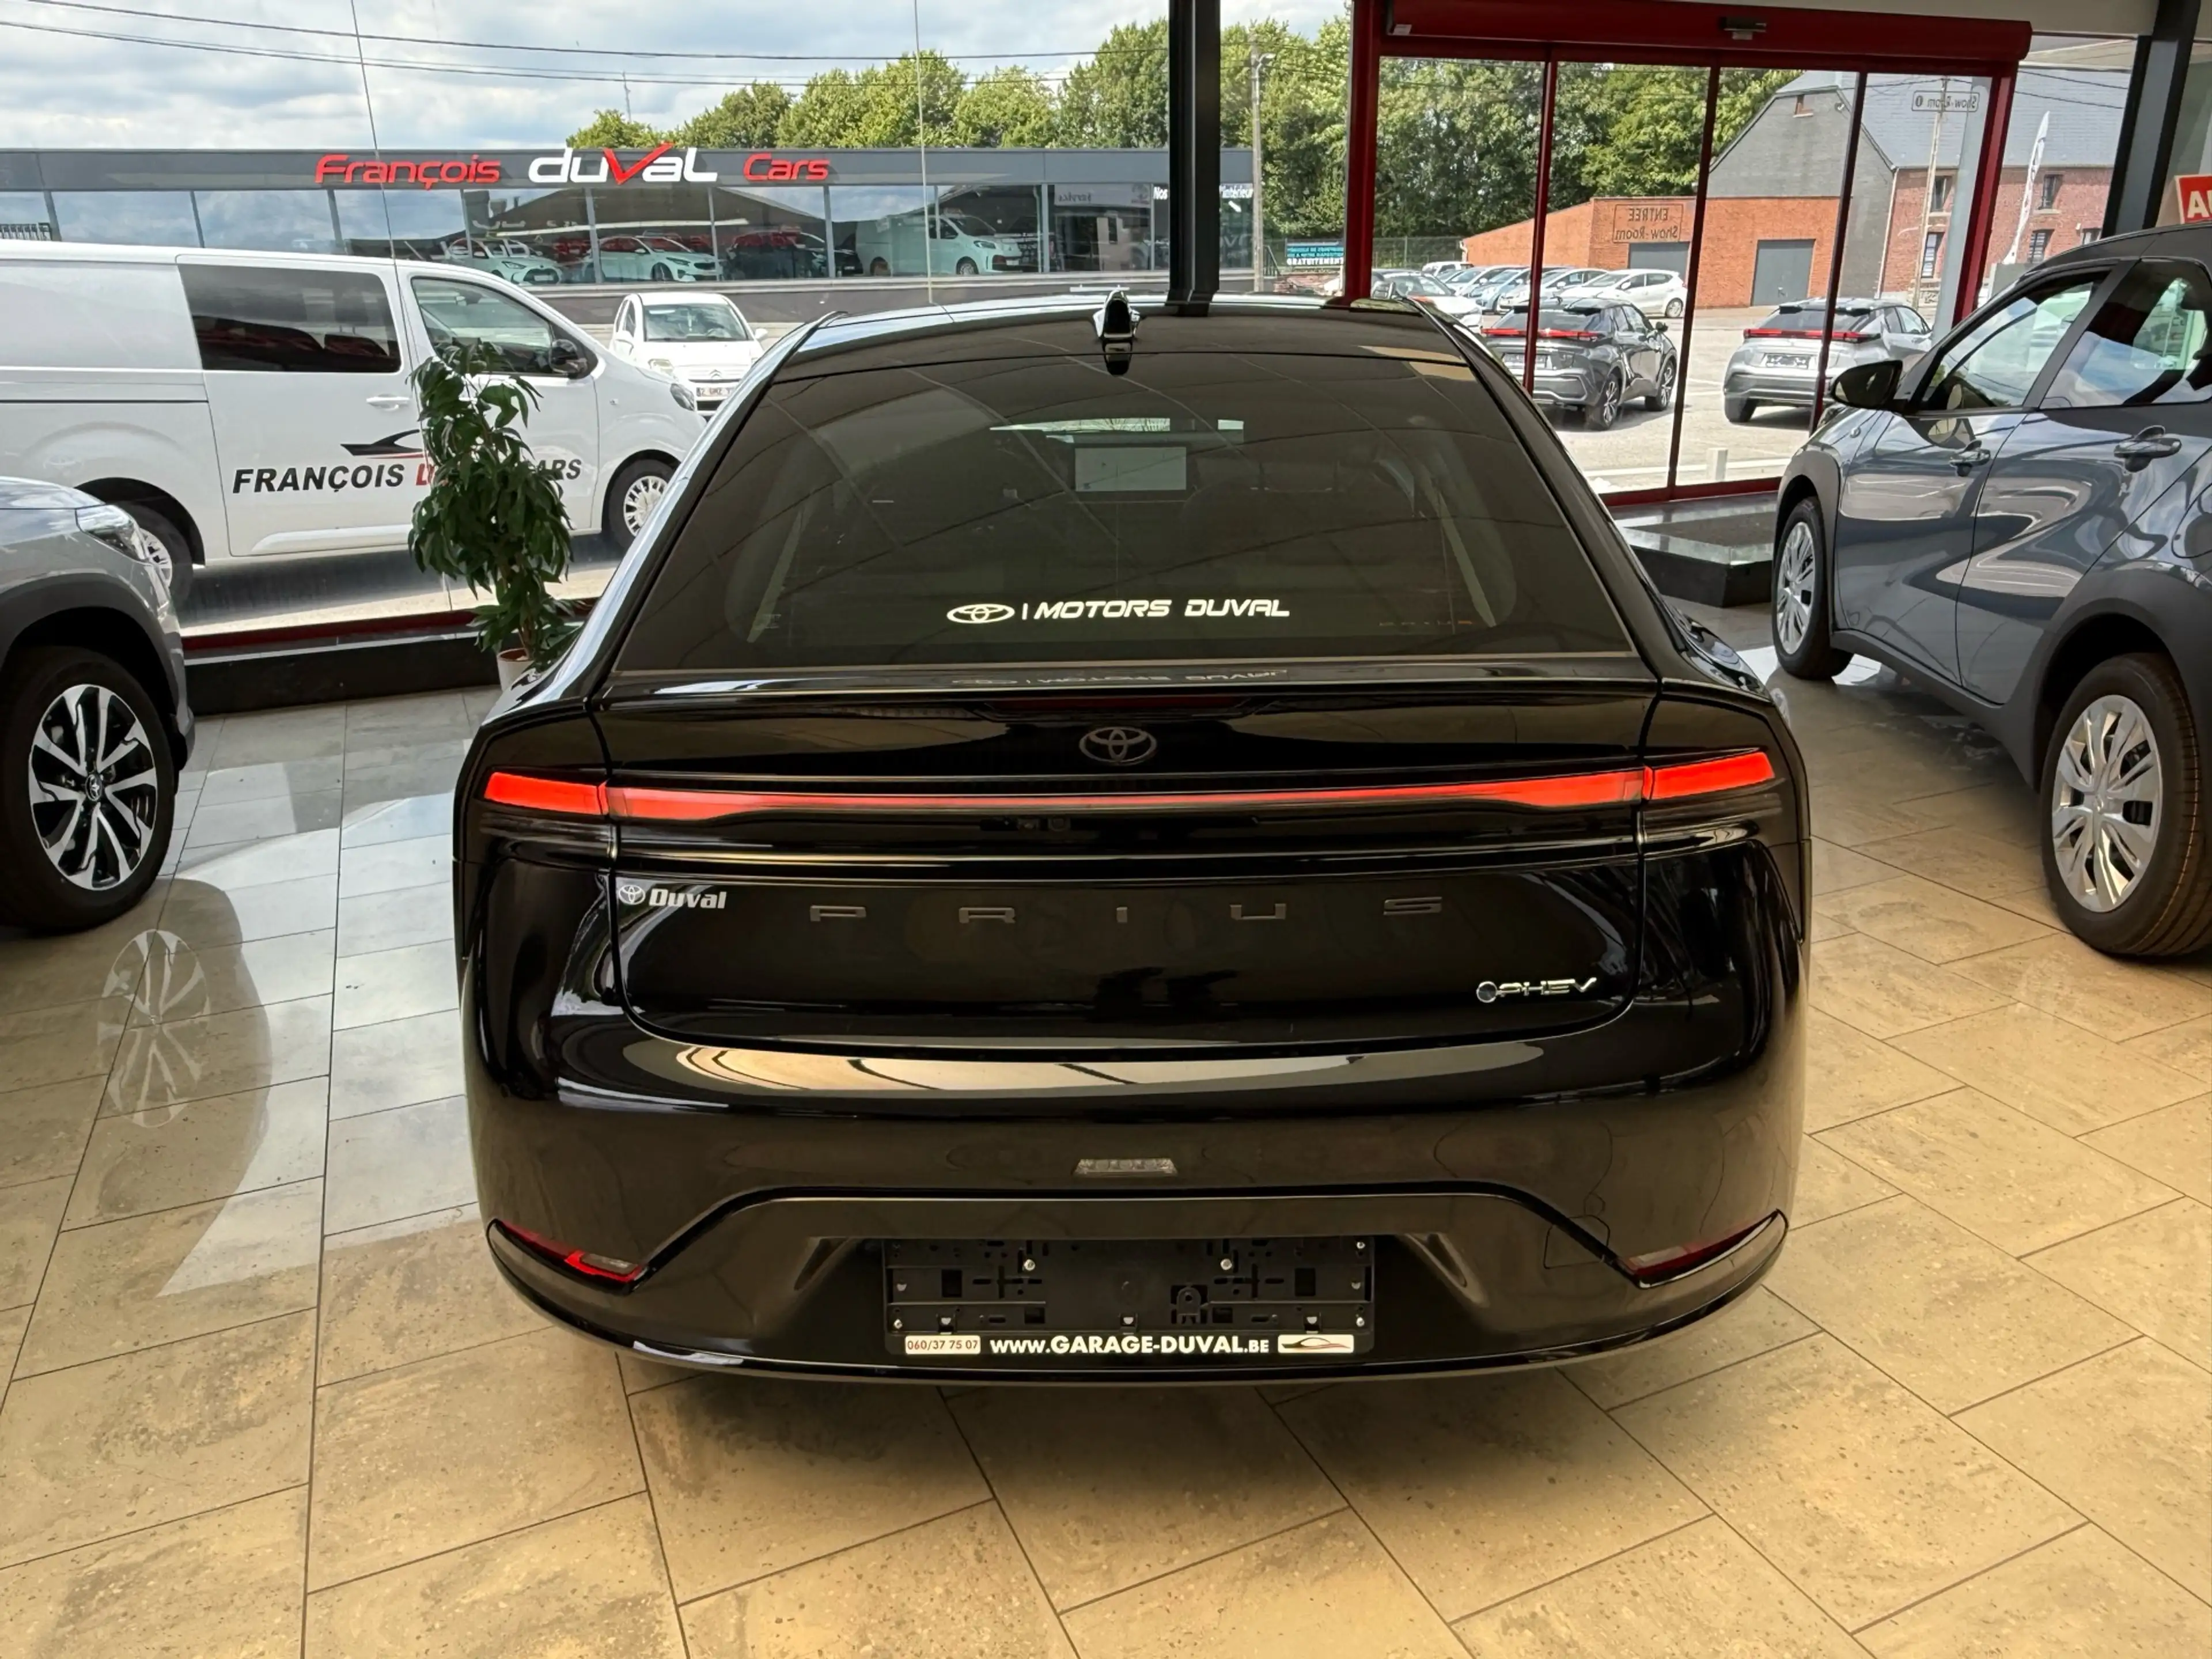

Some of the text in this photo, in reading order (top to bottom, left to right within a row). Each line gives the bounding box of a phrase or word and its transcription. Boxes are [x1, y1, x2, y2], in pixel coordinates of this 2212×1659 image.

[314, 153, 501, 191] François
[743, 153, 832, 181] Cars
[1153, 187, 1168, 200] Nos
[232, 464, 404, 494] FRANÇOIS
[1033, 599, 1290, 620] MOTORS DUVAL
[649, 887, 728, 910] Duval
[809, 896, 1442, 924] PRIUS
[907, 1340, 978, 1351] 060/37 75 07
